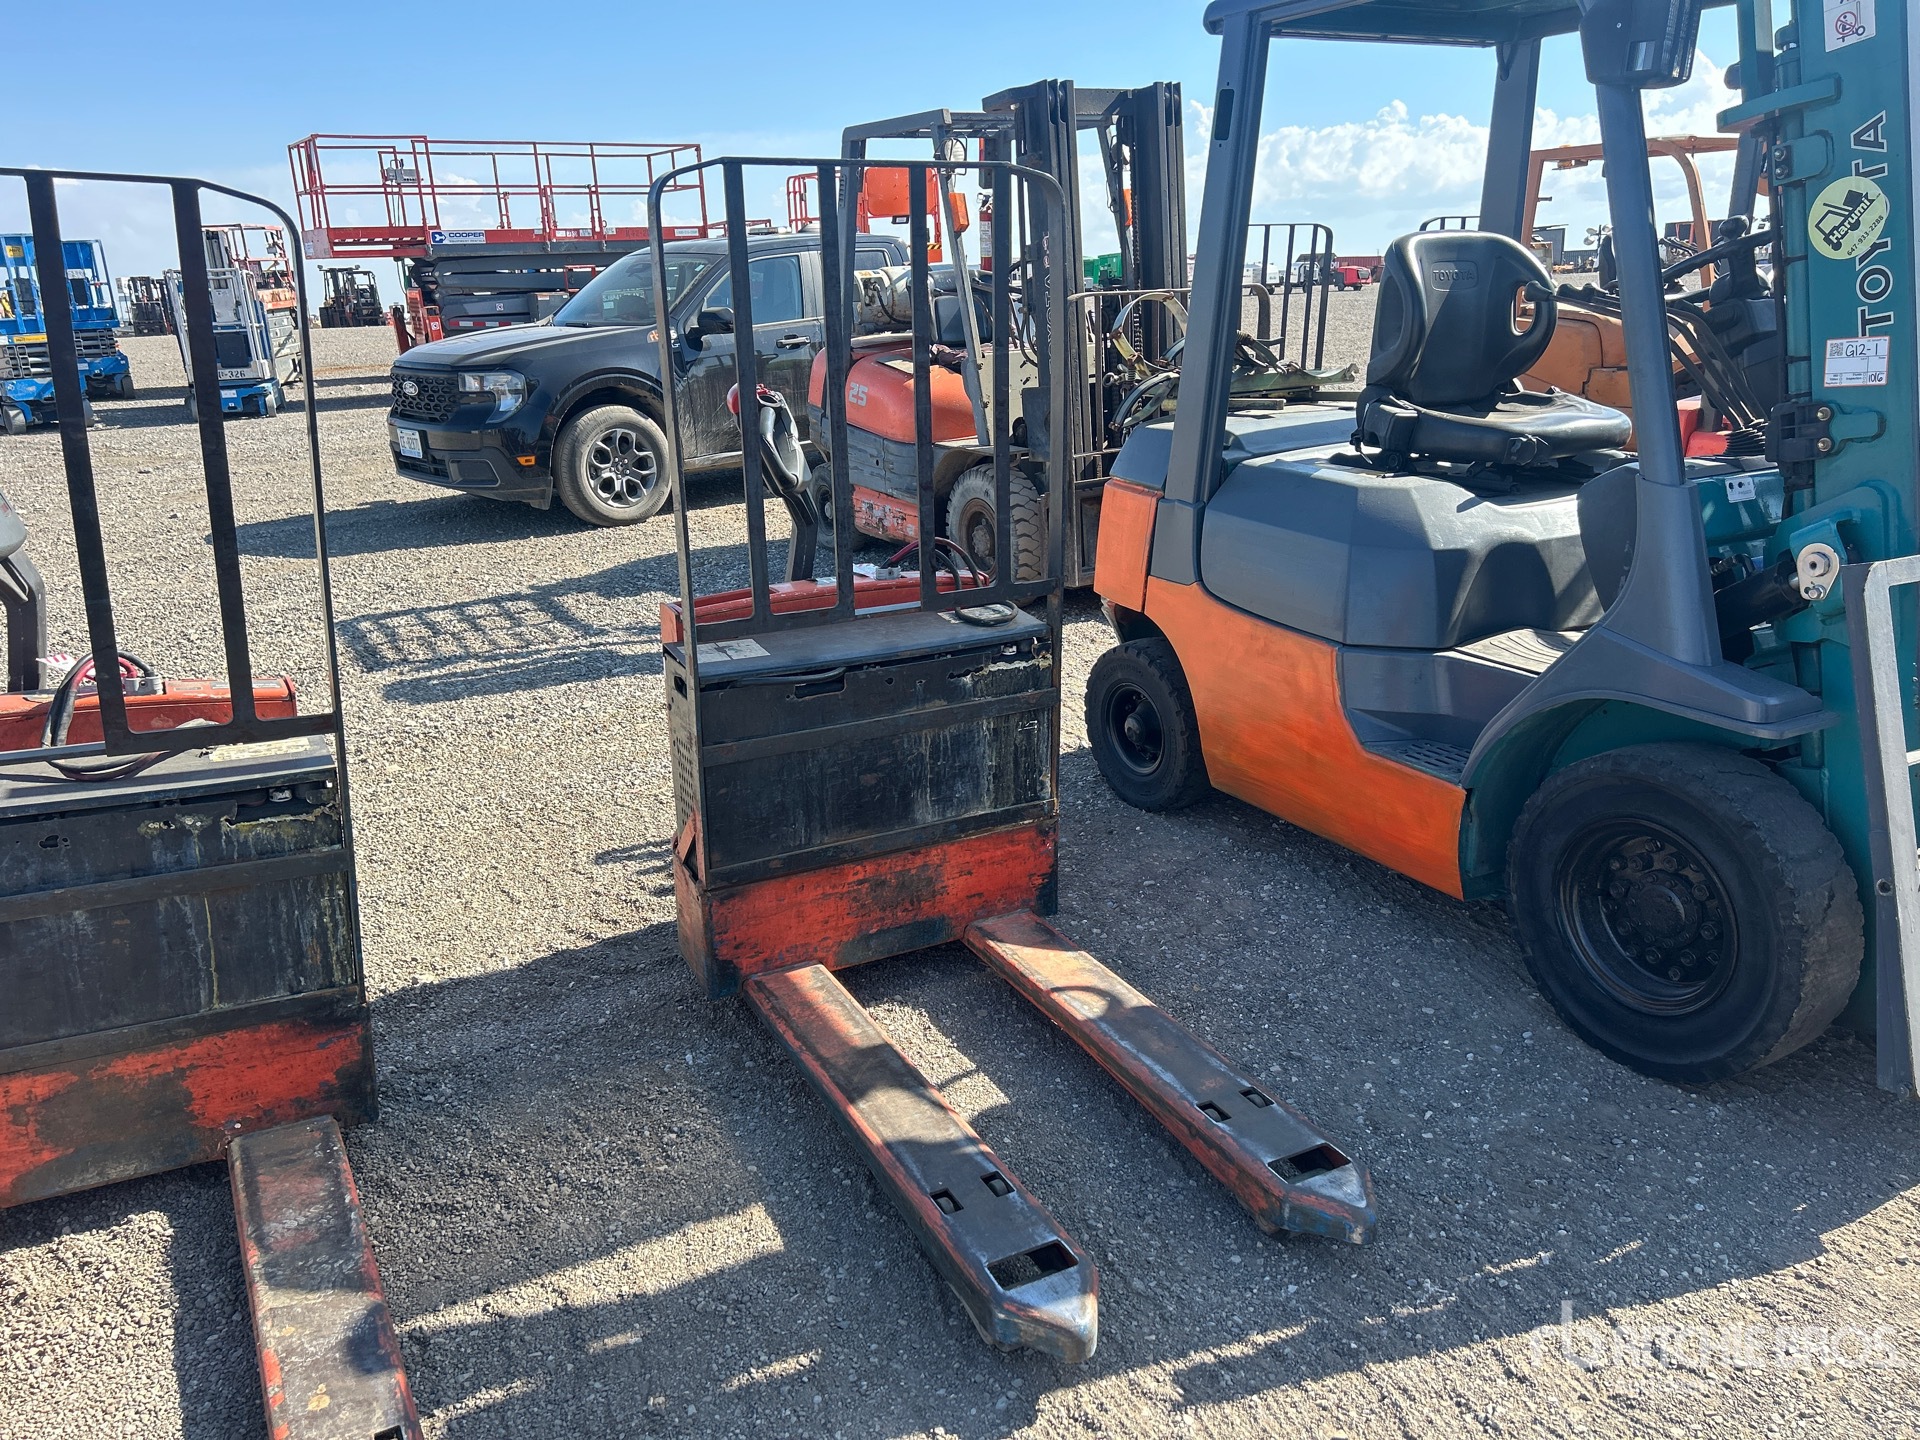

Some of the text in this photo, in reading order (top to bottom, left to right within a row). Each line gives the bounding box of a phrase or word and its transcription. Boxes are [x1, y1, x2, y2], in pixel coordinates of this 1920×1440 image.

[1828, 196, 1871, 244] Harumi
[1850, 109, 1894, 338] TOYTA
[1432, 269, 1475, 281] TOYOTA
[848, 381, 869, 407] 25
